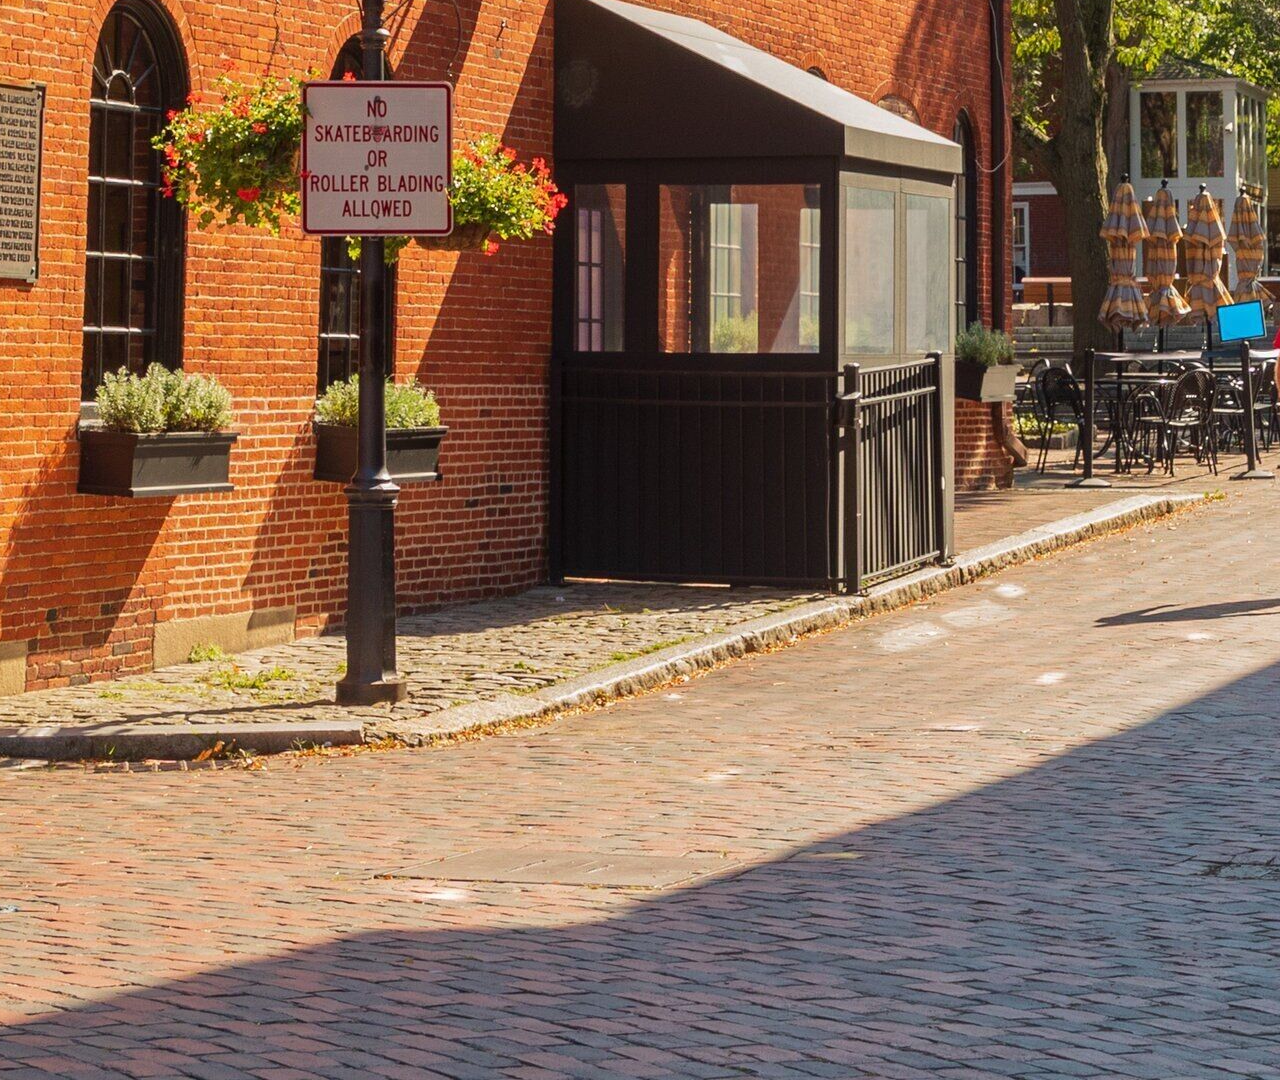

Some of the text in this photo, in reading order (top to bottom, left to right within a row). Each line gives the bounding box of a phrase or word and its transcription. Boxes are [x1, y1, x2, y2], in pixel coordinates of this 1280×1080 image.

[366, 100, 387, 118] NO
[367, 150, 388, 168] OR
[310, 175, 444, 192] ROLLER BLADING
[342, 200, 412, 218] ALLOWED
